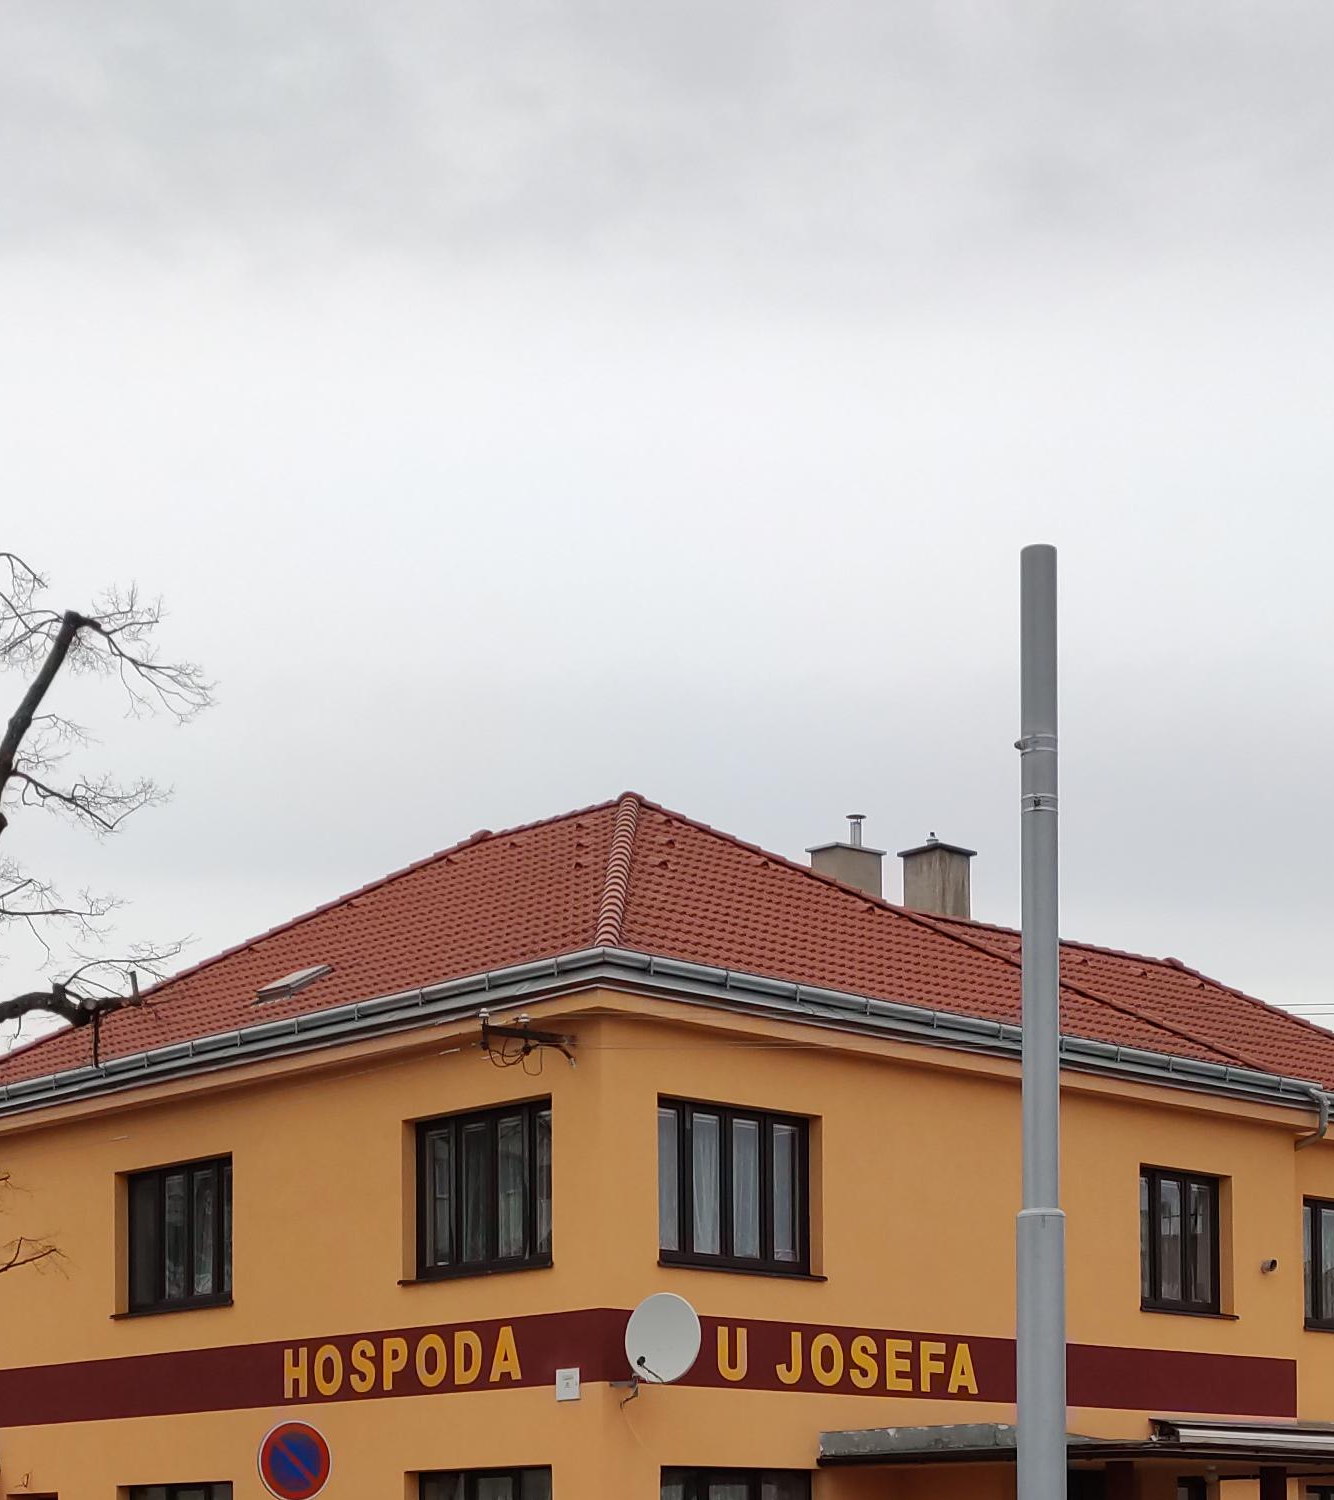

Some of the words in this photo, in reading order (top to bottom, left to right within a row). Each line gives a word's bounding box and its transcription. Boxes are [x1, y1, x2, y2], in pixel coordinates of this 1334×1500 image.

[283, 1325, 522, 1399] HOSPODA
[717, 1325, 748, 1382] U
[775, 1331, 979, 1395] JOSEFA
